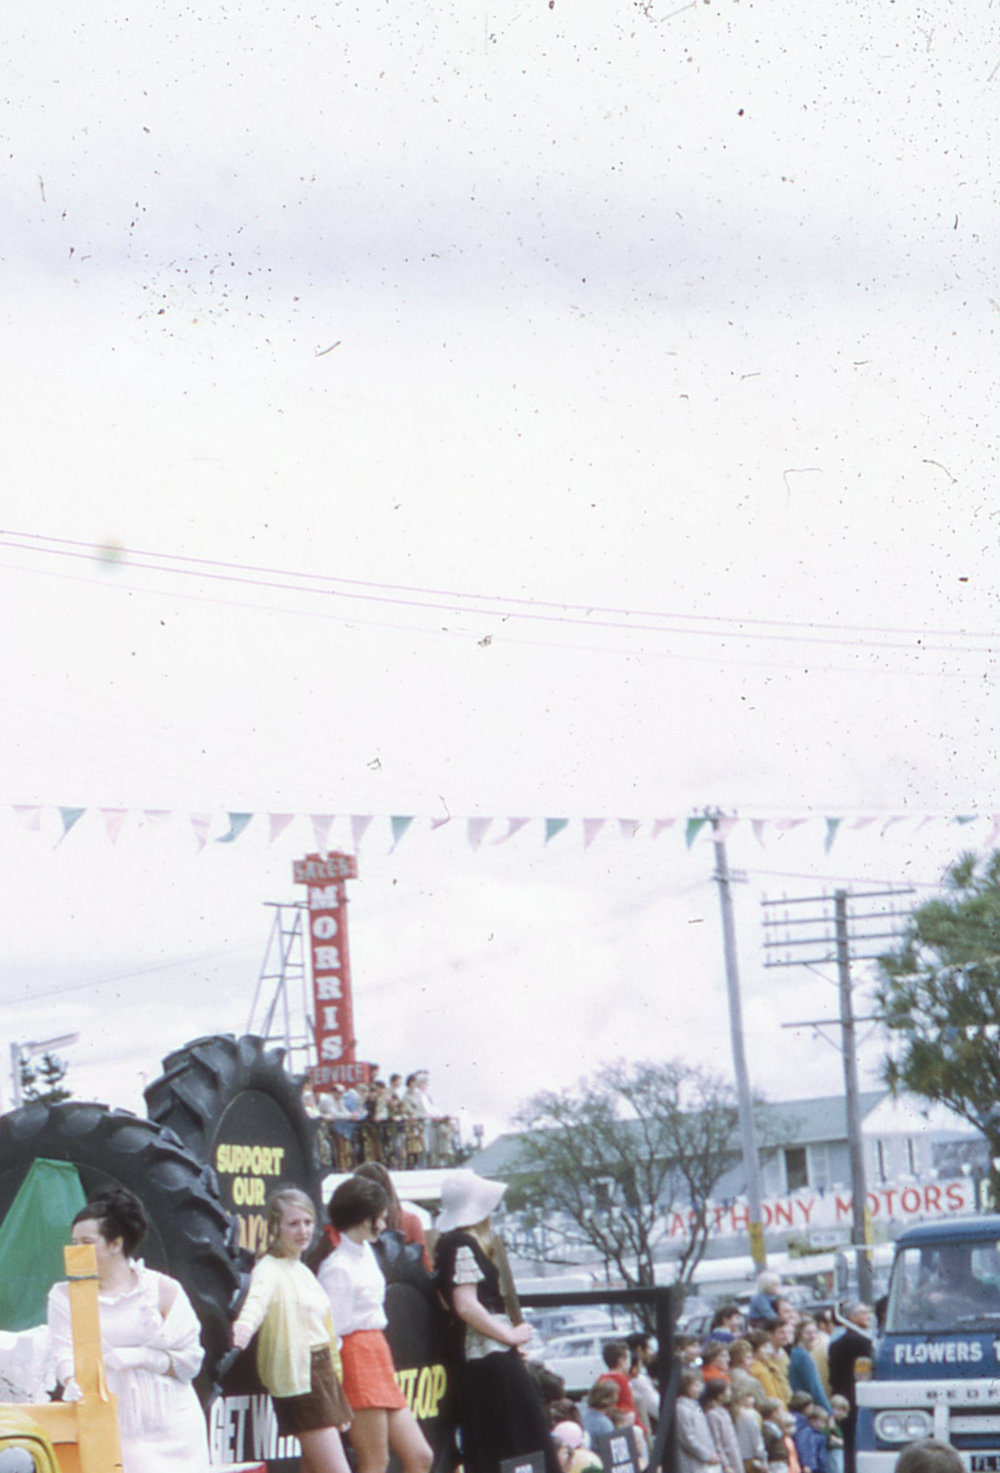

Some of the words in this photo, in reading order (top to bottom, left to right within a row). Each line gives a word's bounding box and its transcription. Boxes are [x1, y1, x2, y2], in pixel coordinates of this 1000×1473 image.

[310, 885, 343, 1061] MORRIS
[217, 1144, 284, 1175] SUPPORT
[233, 1176, 266, 1206] OUR
[894, 1340, 983, 1364] FLOWERS
[210, 1395, 250, 1464] GET
[609, 1436, 631, 1465] FOR
